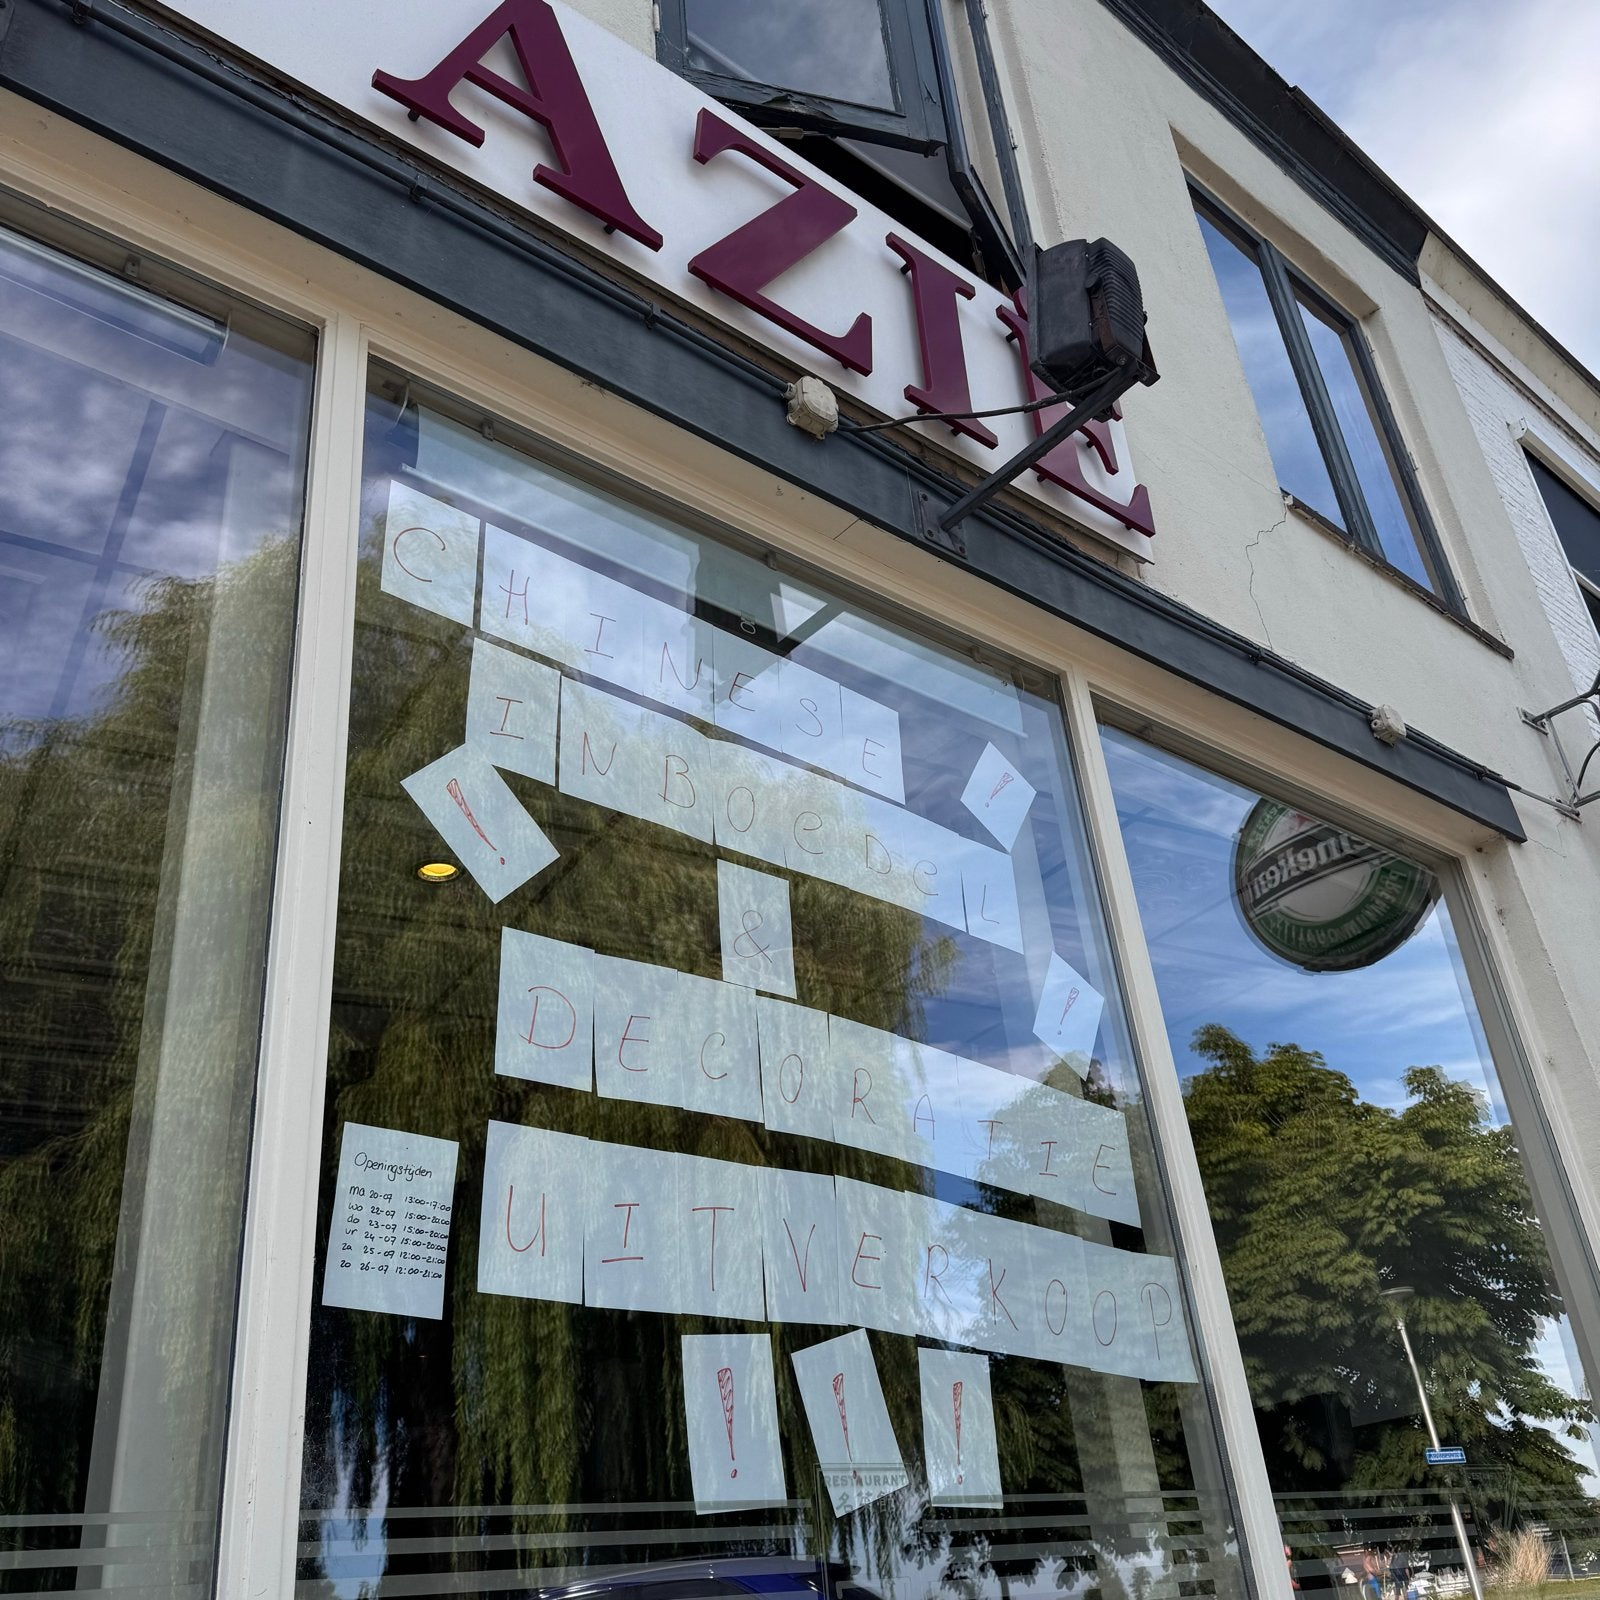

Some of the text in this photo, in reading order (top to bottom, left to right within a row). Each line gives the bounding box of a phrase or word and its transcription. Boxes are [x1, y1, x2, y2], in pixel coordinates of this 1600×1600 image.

[393, 527, 886, 779] CHINESE
[733, 909, 773, 963] &
[519, 985, 1117, 1196] DECORATIE
[346, 1214, 360, 1224] do
[368, 1219, 397, 1233] 23-07
[370, 1205, 396, 1219] 22-07
[506, 1184, 1173, 1361] UITVERKOOP
[824, 1474, 907, 1488] RESTAURANT
